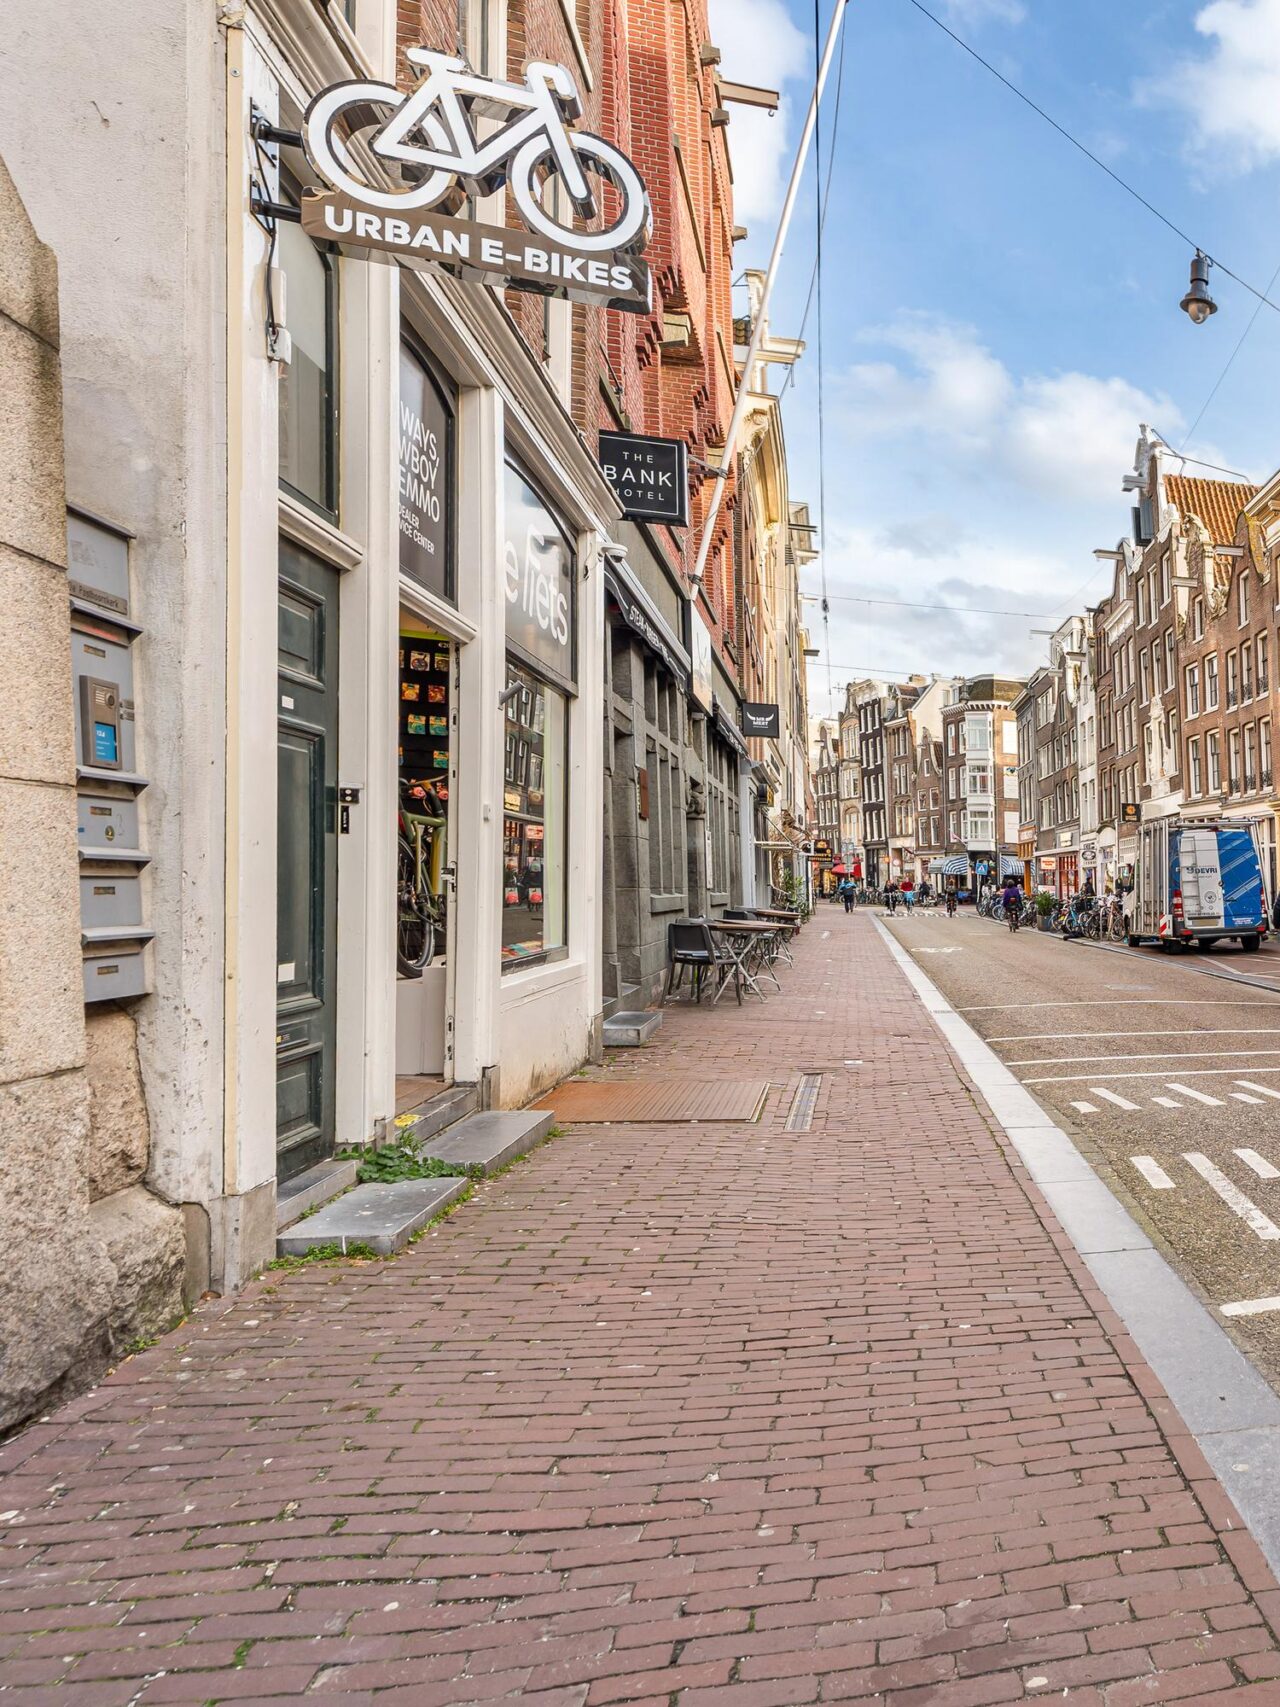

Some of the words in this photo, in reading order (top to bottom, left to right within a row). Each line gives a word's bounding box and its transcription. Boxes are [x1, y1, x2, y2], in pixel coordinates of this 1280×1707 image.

[324, 205, 471, 259] URBAN
[481, 237, 634, 291] E-BIKES
[622, 451, 654, 464] THE
[603, 464, 673, 488] BANK
[413, 530, 435, 555] CENTER
